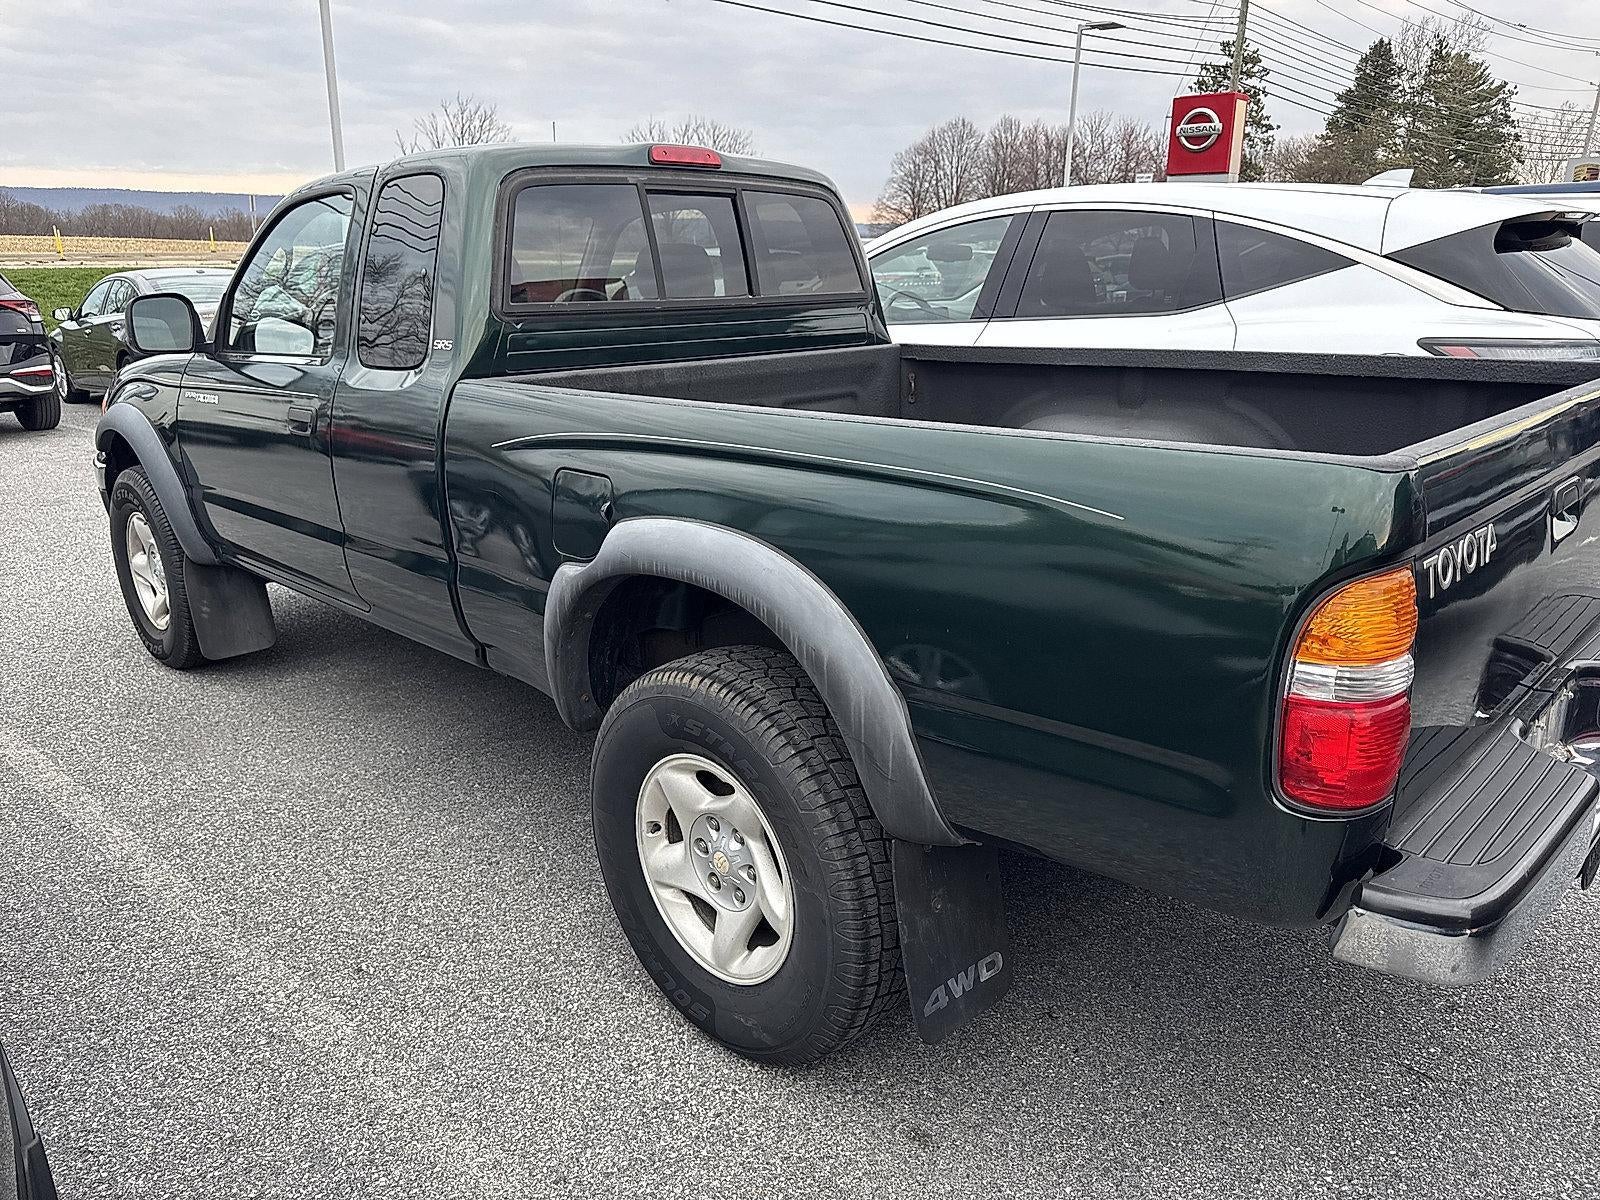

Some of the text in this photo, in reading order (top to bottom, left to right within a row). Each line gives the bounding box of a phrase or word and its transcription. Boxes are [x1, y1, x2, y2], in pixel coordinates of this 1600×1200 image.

[1179, 125, 1217, 134] NISSAN
[1423, 523, 1498, 599] TOYOTA
[923, 951, 1004, 1018] 4WD
